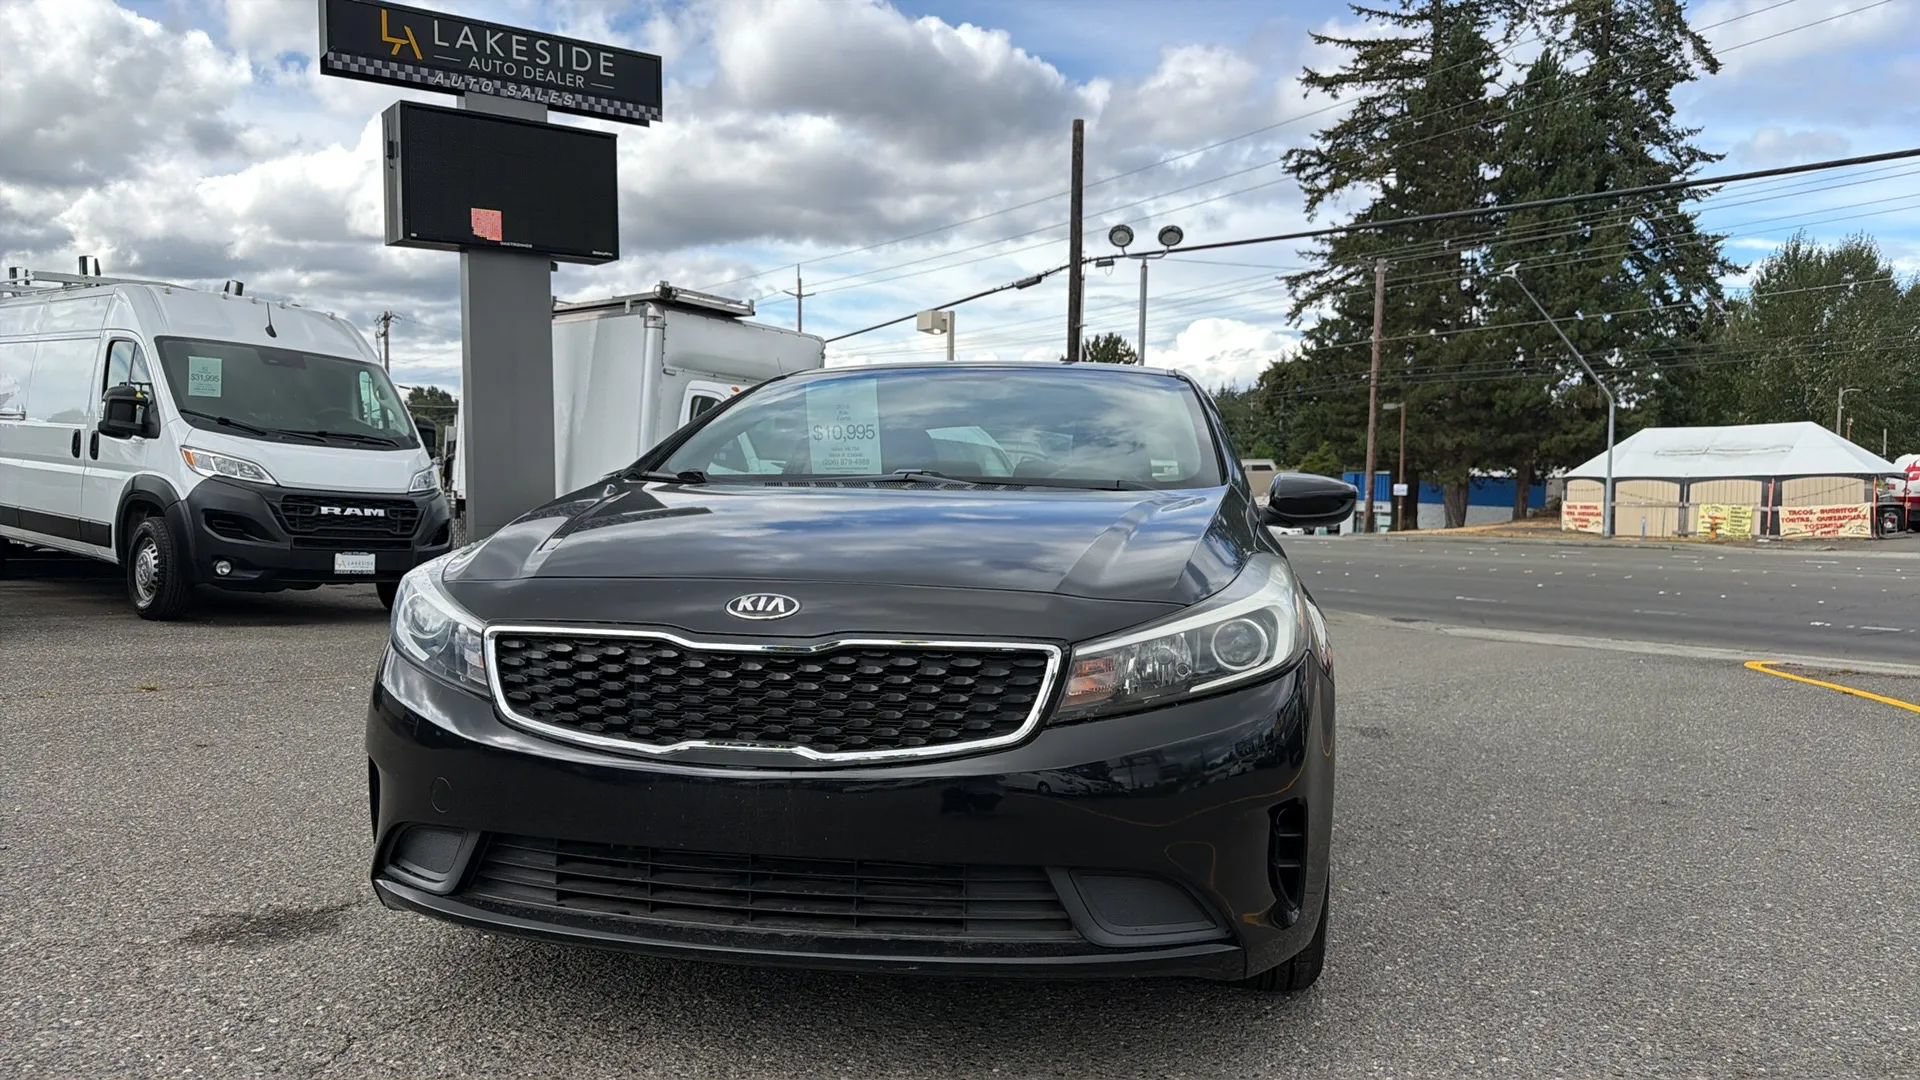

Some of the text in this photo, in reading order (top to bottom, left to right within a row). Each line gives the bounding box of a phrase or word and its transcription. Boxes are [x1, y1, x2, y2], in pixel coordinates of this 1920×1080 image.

[434, 19, 615, 77] LAKESIDE
[468, 56, 585, 89] AUTO DEALER
[433, 72, 574, 106] AUTO SALES
[813, 424, 875, 442] $10,995
[320, 506, 385, 517] RAM
[737, 596, 785, 613] KIA
